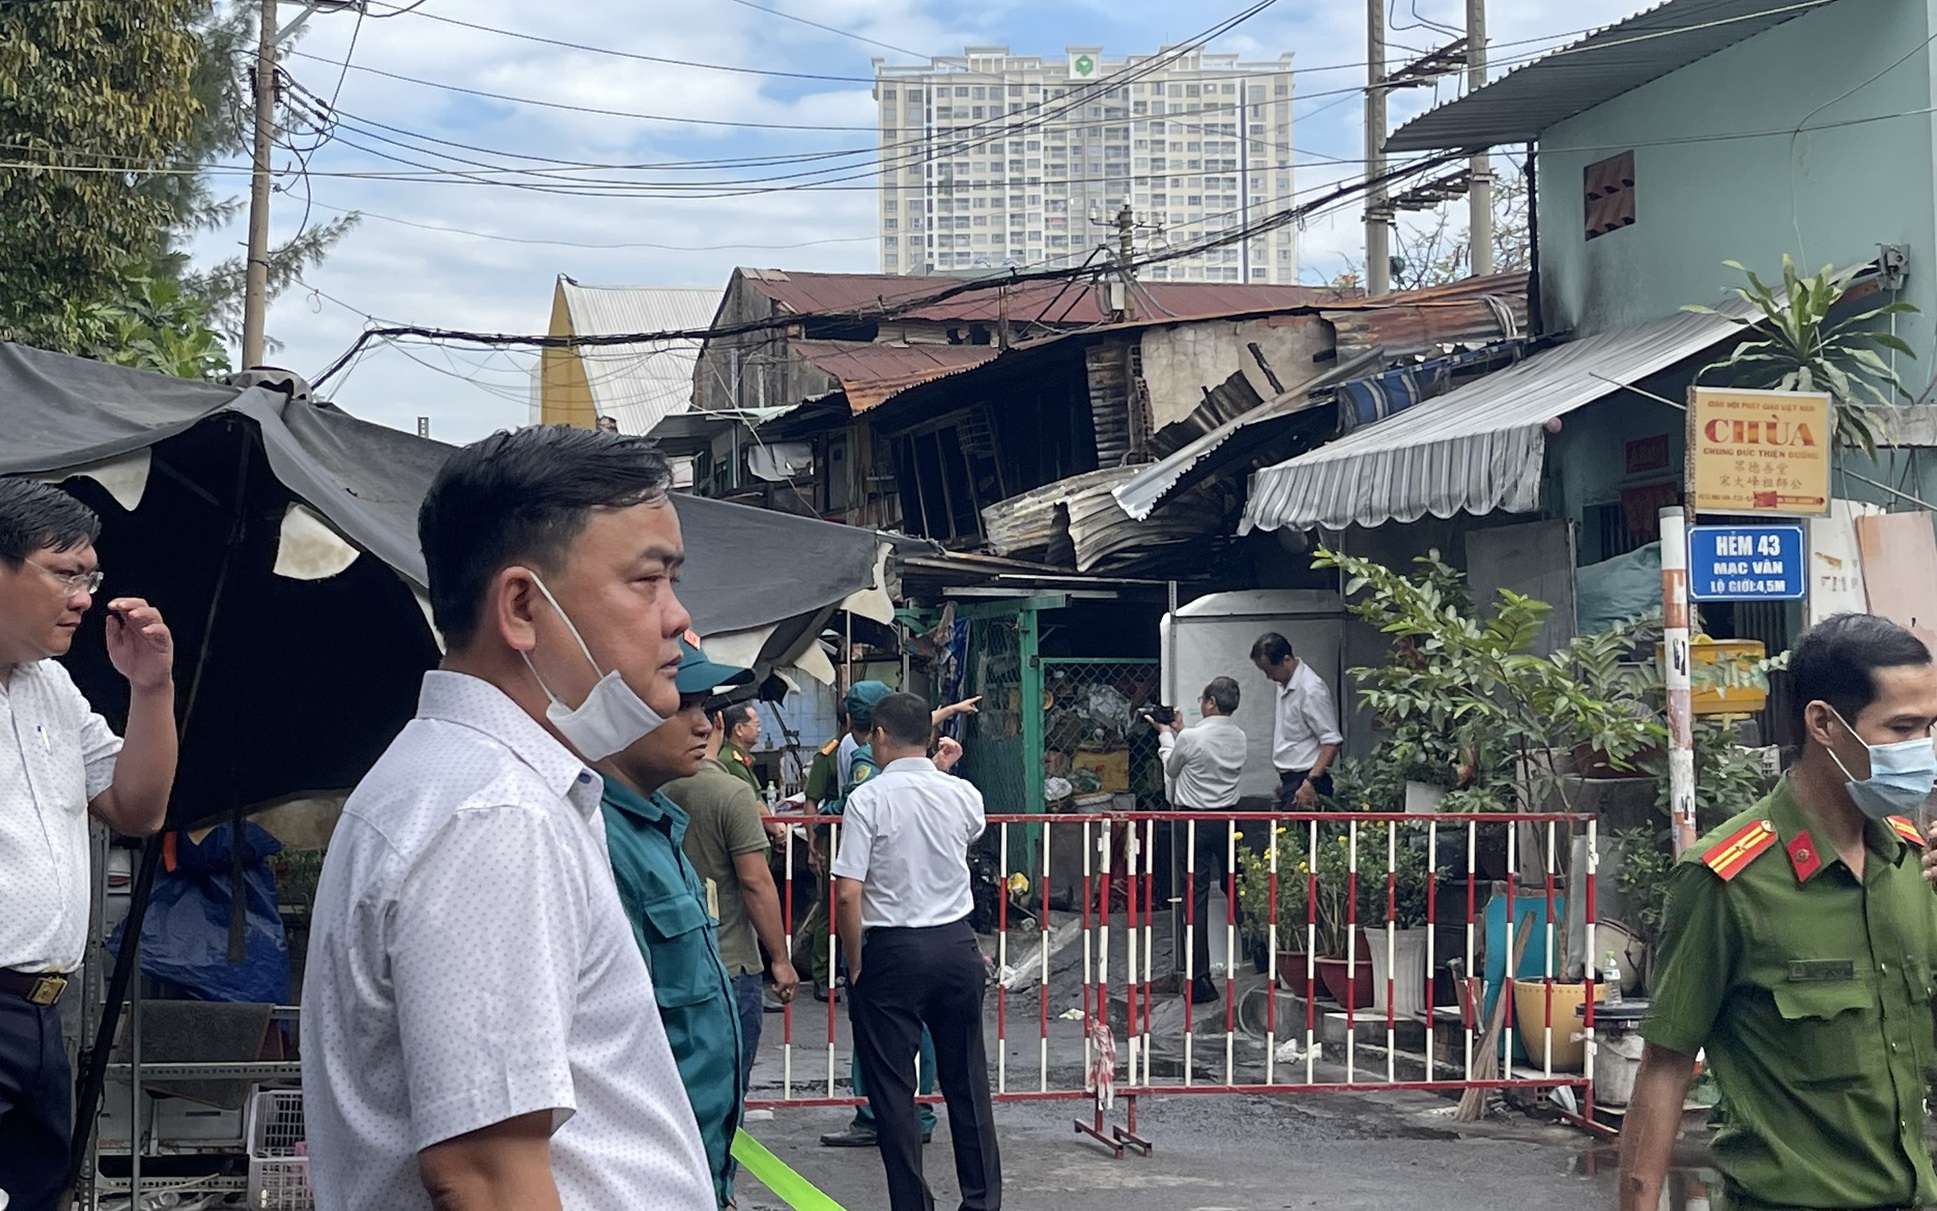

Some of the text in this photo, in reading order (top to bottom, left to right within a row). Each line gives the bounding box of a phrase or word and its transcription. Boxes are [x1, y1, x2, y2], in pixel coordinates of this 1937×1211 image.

[1704, 414, 1817, 447] CHÙA
[1703, 447, 1734, 456] CHUNG
[1715, 530, 1781, 556] HẺM 43
[1713, 558, 1784, 577] MẠC VÂN
[1710, 578, 1726, 594] LỘ
